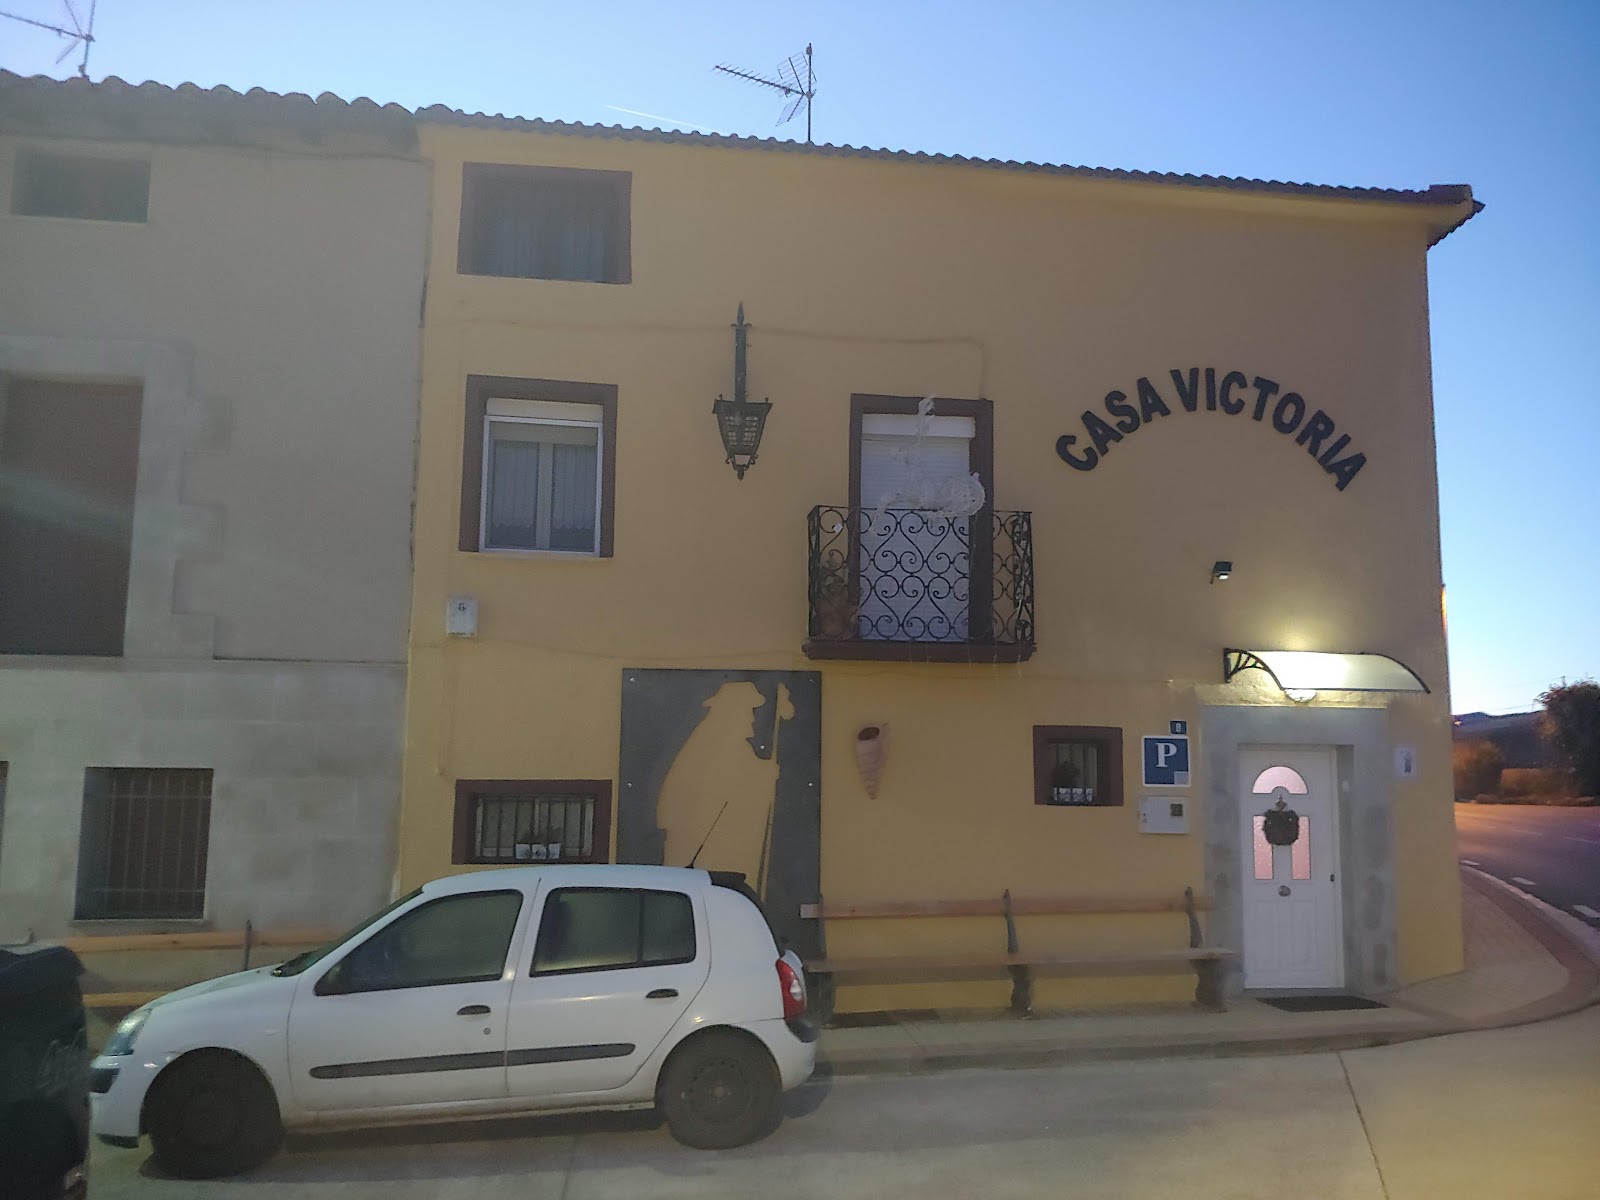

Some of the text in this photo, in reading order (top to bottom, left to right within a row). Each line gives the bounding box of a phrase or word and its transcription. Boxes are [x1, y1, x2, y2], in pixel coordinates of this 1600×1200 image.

[1056, 367, 1367, 491] CASA VICTORIA
[1155, 742, 1178, 768] P
